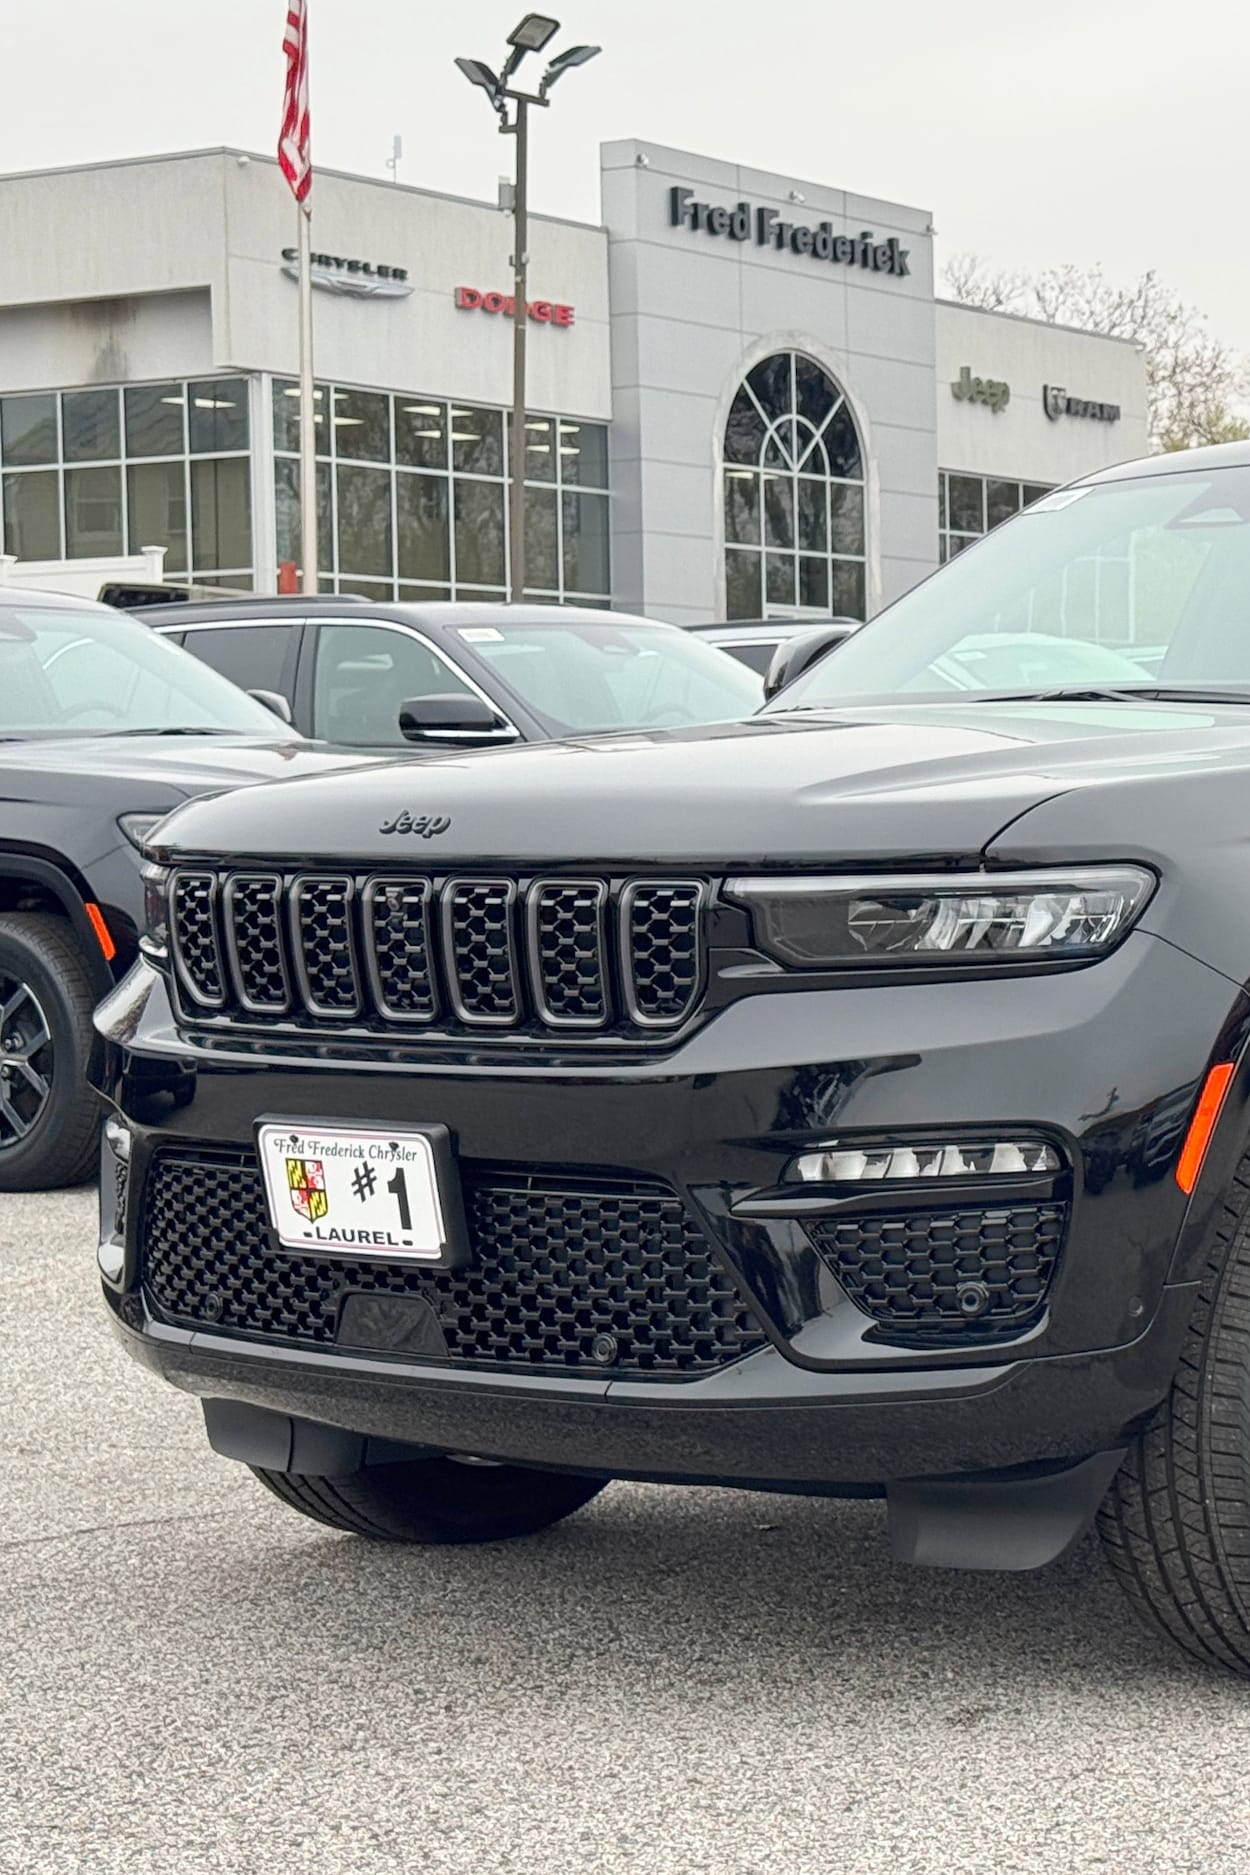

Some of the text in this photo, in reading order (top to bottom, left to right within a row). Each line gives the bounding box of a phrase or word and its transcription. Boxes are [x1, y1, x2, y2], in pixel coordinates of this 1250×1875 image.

[670, 186, 910, 277] Fred Frederick
[951, 366, 1010, 415] Jeep
[1065, 397, 1121, 423] RAM
[379, 809, 451, 839] Jeep
[273, 1138, 417, 1163] Fred Frederick Chrysler
[315, 1226, 399, 1247] LAUREL
